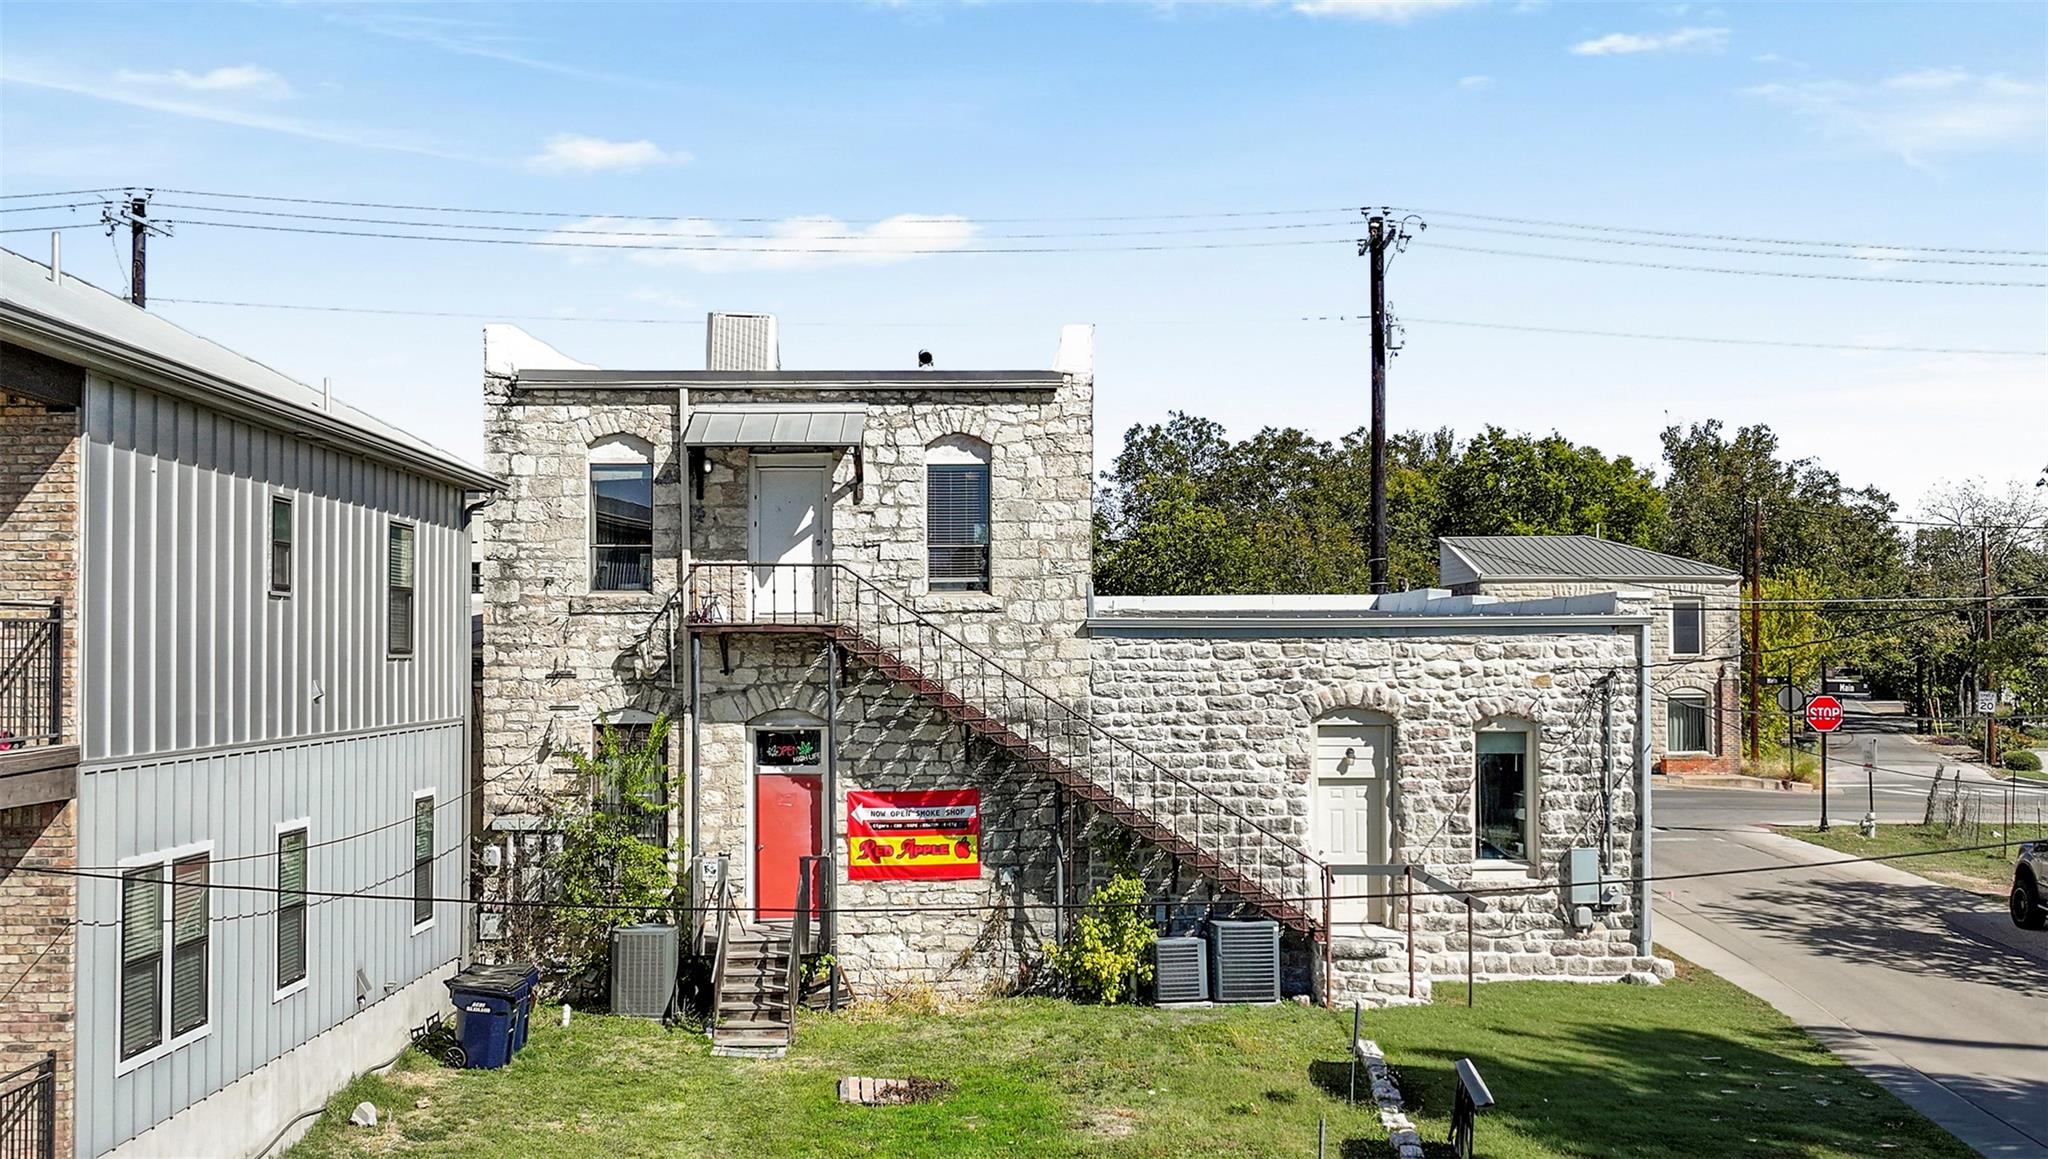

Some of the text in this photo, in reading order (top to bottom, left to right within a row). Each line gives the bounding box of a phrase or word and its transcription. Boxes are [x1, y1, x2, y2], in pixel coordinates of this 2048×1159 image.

[1839, 683, 1855, 692] Main
[1980, 702, 1994, 711] 20
[1809, 707, 1840, 720] STOP
[890, 809, 911, 818] OPEN
[916, 809, 941, 817] SMOKE
[945, 808, 966, 816] SHOP
[857, 838, 950, 864] RED APPLE
